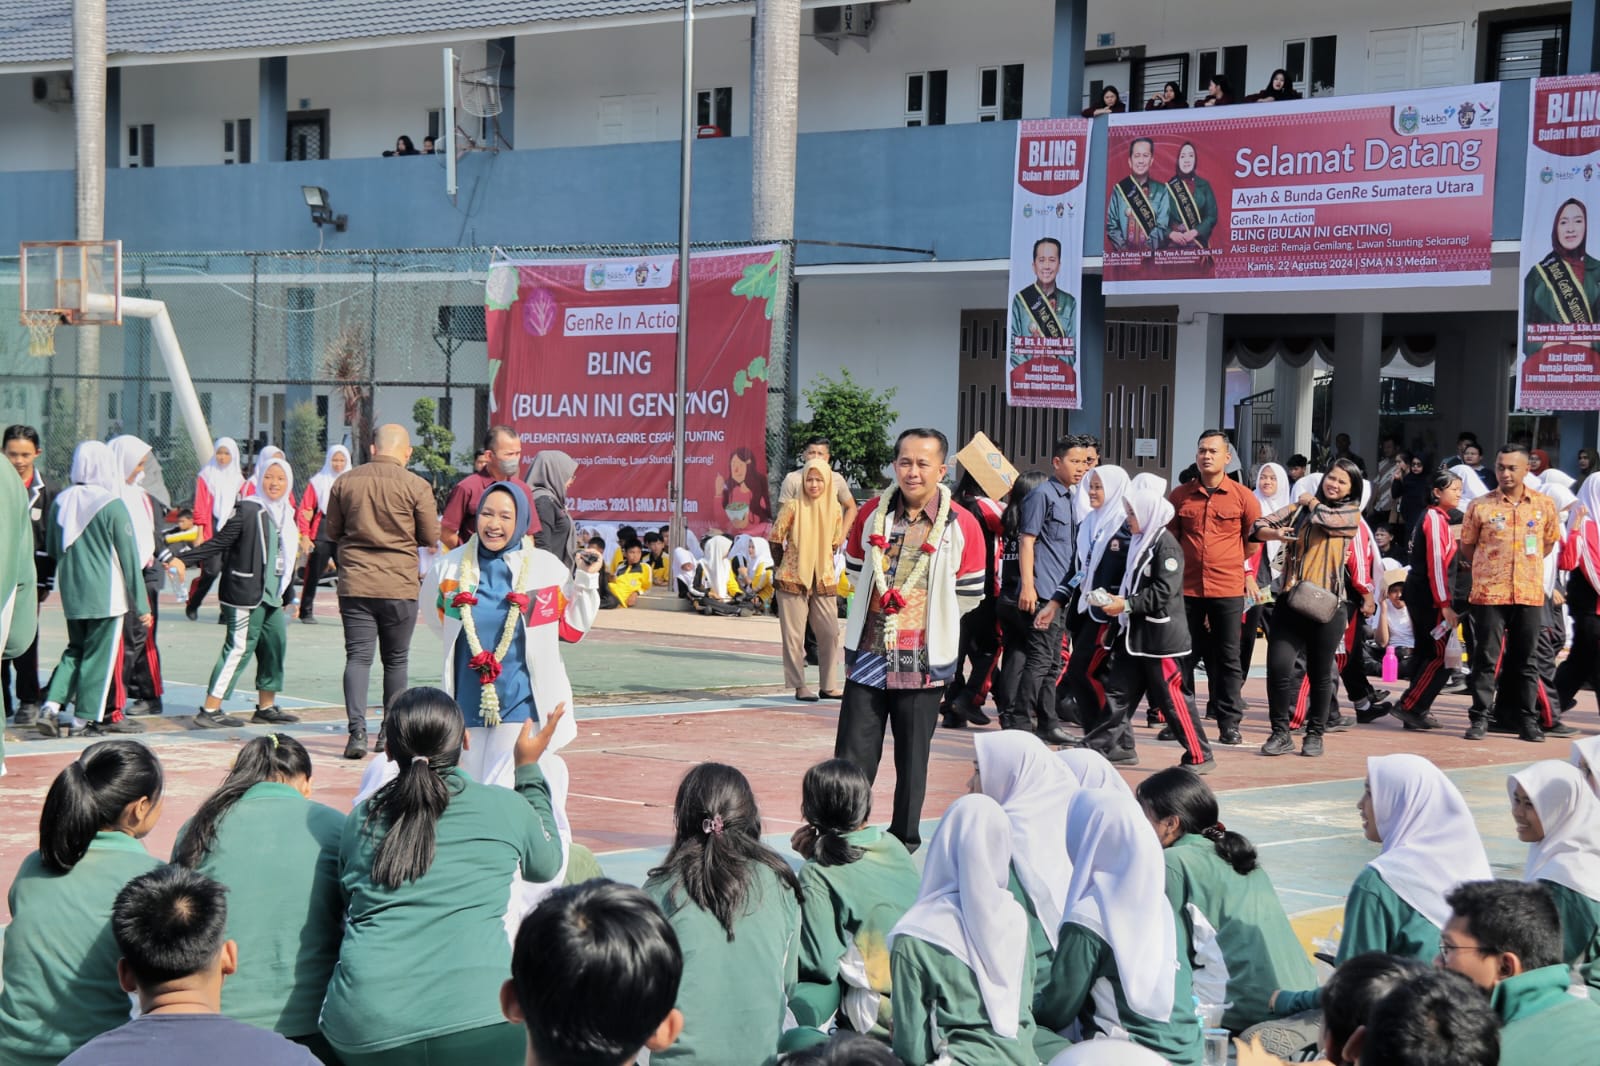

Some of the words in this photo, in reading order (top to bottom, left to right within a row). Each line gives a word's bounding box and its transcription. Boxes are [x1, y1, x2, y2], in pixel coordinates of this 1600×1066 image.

[1566, 126, 1578, 138] INI
[1028, 140, 1076, 167] BLING
[1234, 144, 1356, 178] Selamat
[1364, 137, 1482, 171] Datang
[1237, 191, 1268, 206] Ayah
[1270, 190, 1280, 203] &
[1284, 188, 1322, 202] Bunda
[1326, 186, 1368, 200] GenRe
[1372, 184, 1432, 198] Sumatera
[1436, 180, 1474, 194] Utara
[1231, 214, 1265, 226] GenRe
[1268, 214, 1278, 224] In
[1280, 212, 1314, 223] Action
[1230, 228, 1264, 240] BLING
[1268, 228, 1310, 241] (BULAN
[1314, 226, 1330, 238] INI
[1333, 222, 1392, 236] GENTING)
[1230, 244, 1248, 254] Aksi
[1282, 242, 1310, 254] Remaja
[1356, 240, 1384, 248] Lawan
[1386, 238, 1424, 248] Stunting
[1426, 236, 1470, 246] Sekarang!
[1247, 262, 1276, 272] Kamis,
[1278, 261, 1290, 270] 22
[1292, 260, 1327, 271] Agustus
[1330, 260, 1352, 269] 2024
[1360, 258, 1382, 268] SMA
[1386, 258, 1393, 267] N
[1396, 257, 1402, 266] 3
[1404, 256, 1438, 266] Medan
[566, 313, 614, 332] GenRe
[618, 312, 632, 330] In
[587, 350, 652, 376] BLING
[512, 394, 588, 421] (BULAN
[594, 393, 623, 417] INI
[582, 433, 615, 444] NYATA
[616, 432, 646, 444] GENRE
[577, 498, 608, 512] Agustus
[609, 498, 630, 512] 2024
[636, 498, 654, 512] SMA
[661, 498, 667, 512] 3
